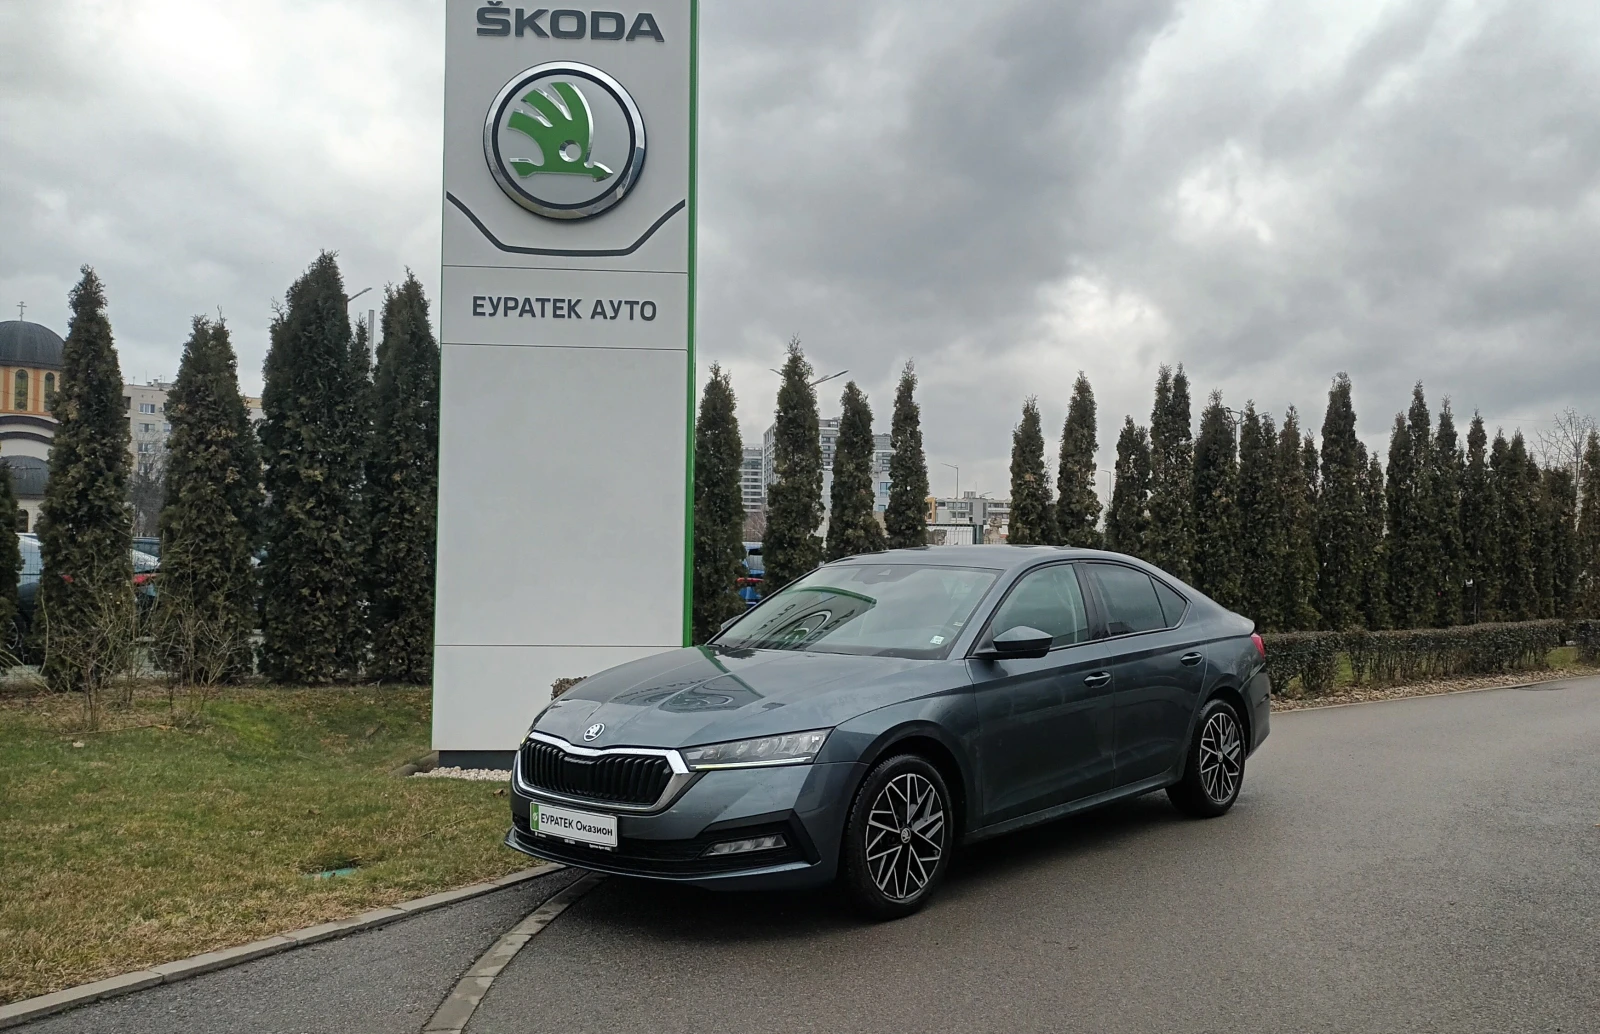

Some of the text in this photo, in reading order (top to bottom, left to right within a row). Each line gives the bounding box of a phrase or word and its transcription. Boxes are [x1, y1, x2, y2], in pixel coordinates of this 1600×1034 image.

[476, 1, 665, 42] ŠKODA
[472, 296, 657, 321] ЕУРАТЕК АУТО
[540, 813, 613, 836] ЕУРАТЕК Оказион
